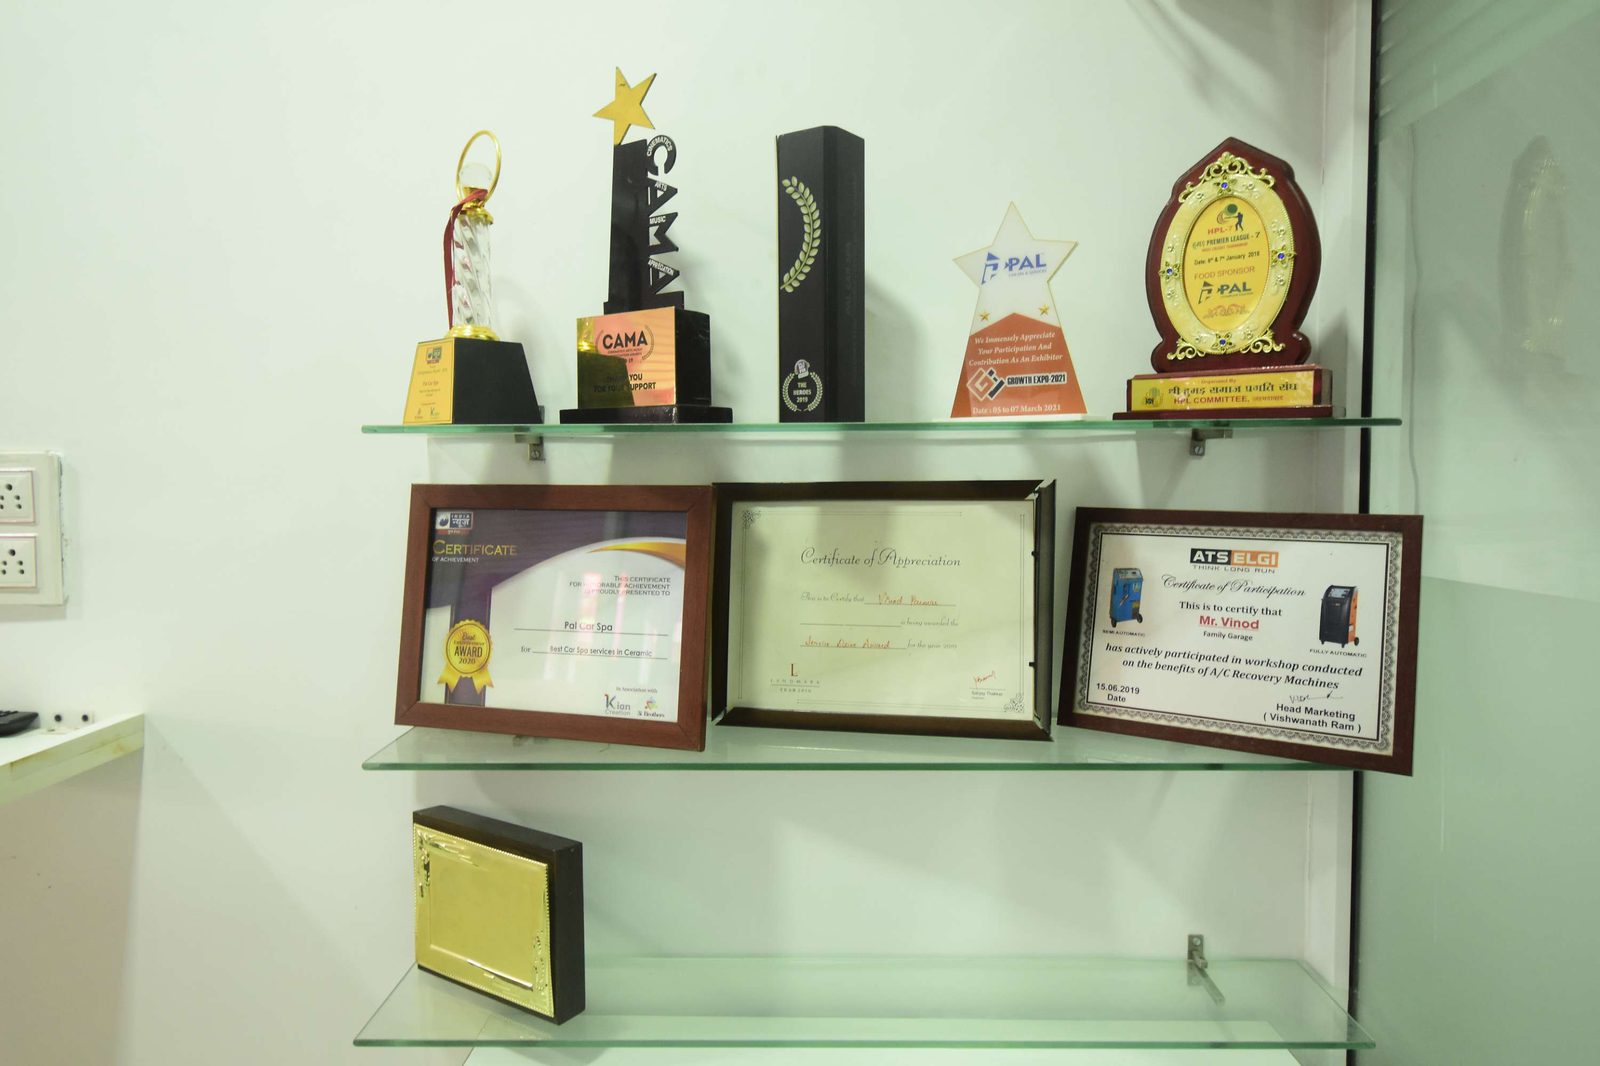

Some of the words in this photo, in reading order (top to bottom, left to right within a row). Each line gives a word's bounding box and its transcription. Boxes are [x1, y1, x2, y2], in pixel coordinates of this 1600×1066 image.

[649, 216, 666, 225] MUSIC
[1206, 237, 1230, 246] PREMIER
[1230, 233, 1250, 243] LEAGUE
[1006, 254, 1046, 272] PAL
[1194, 272, 1216, 280] FOOD
[1216, 266, 1256, 276] SPONSOR
[1219, 282, 1252, 294] PAL
[602, 330, 648, 349] CAMA
[985, 334, 1019, 344] Immensely
[1020, 332, 1056, 342] Appreciate
[994, 345, 1036, 354] Participation
[969, 358, 1009, 366] Contribution
[1031, 354, 1063, 362] Exhibitor
[1007, 376, 1032, 385] GROWTH
[800, 547, 860, 568] Certificate
[864, 548, 876, 568] of
[878, 548, 960, 568] Appreciation
[1192, 550, 1230, 564] ATS
[1232, 552, 1277, 566] ELGI
[1162, 574, 1216, 593] Certificate
[1216, 580, 1230, 594] of
[1230, 578, 1305, 598] Participation
[1180, 601, 1200, 610] This
[1203, 602, 1210, 611] is
[1213, 604, 1222, 612] to
[1226, 604, 1260, 616] certify
[1261, 607, 1282, 616] that
[564, 622, 577, 630] Pal
[580, 622, 594, 630] Car
[596, 622, 612, 632] Spa
[1200, 615, 1218, 626] Mr.
[1221, 616, 1260, 630] Vinod
[1203, 630, 1226, 640] Family
[1228, 633, 1253, 642] Garage
[454, 646, 482, 658] AWARD
[576, 646, 588, 655] Spa
[624, 649, 652, 657] Ceramic
[1329, 650, 1368, 658] AUTOMATIC
[1106, 642, 1122, 652] has
[1124, 646, 1163, 658] actively
[1164, 650, 1230, 664] participated
[1231, 655, 1242, 665] in
[1245, 658, 1300, 672] workshop
[1302, 664, 1363, 677] conducted
[1136, 660, 1152, 669] the
[1154, 660, 1196, 674] benefits
[1197, 666, 1210, 678] of
[1210, 668, 1230, 679] A/C
[1232, 670, 1283, 685] Recovery
[1284, 674, 1340, 690] Machines
[1096, 682, 1140, 694] 15.06.2019
[1107, 693, 1126, 702] Date
[1276, 703, 1302, 714] Head
[1304, 706, 1356, 722] Marketing
[1270, 712, 1328, 728] Vishwanath
[1331, 720, 1354, 732] Ram
